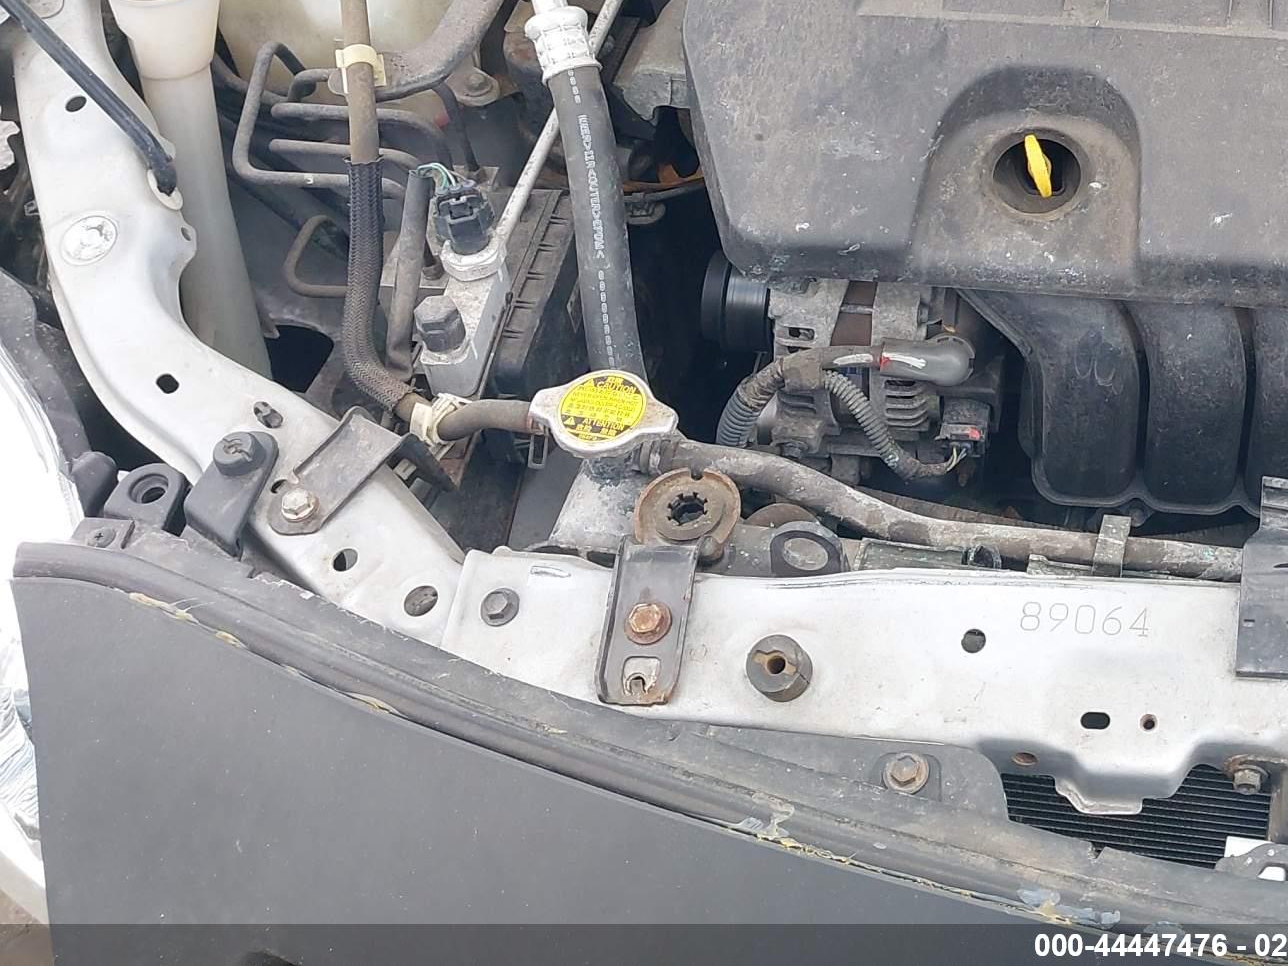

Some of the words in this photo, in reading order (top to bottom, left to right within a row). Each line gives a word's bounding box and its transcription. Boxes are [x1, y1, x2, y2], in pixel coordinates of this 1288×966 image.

[596, 381, 637, 394] CAUTION
[582, 417, 625, 431] ATTENTION
[1020, 601, 1149, 637] 89064
